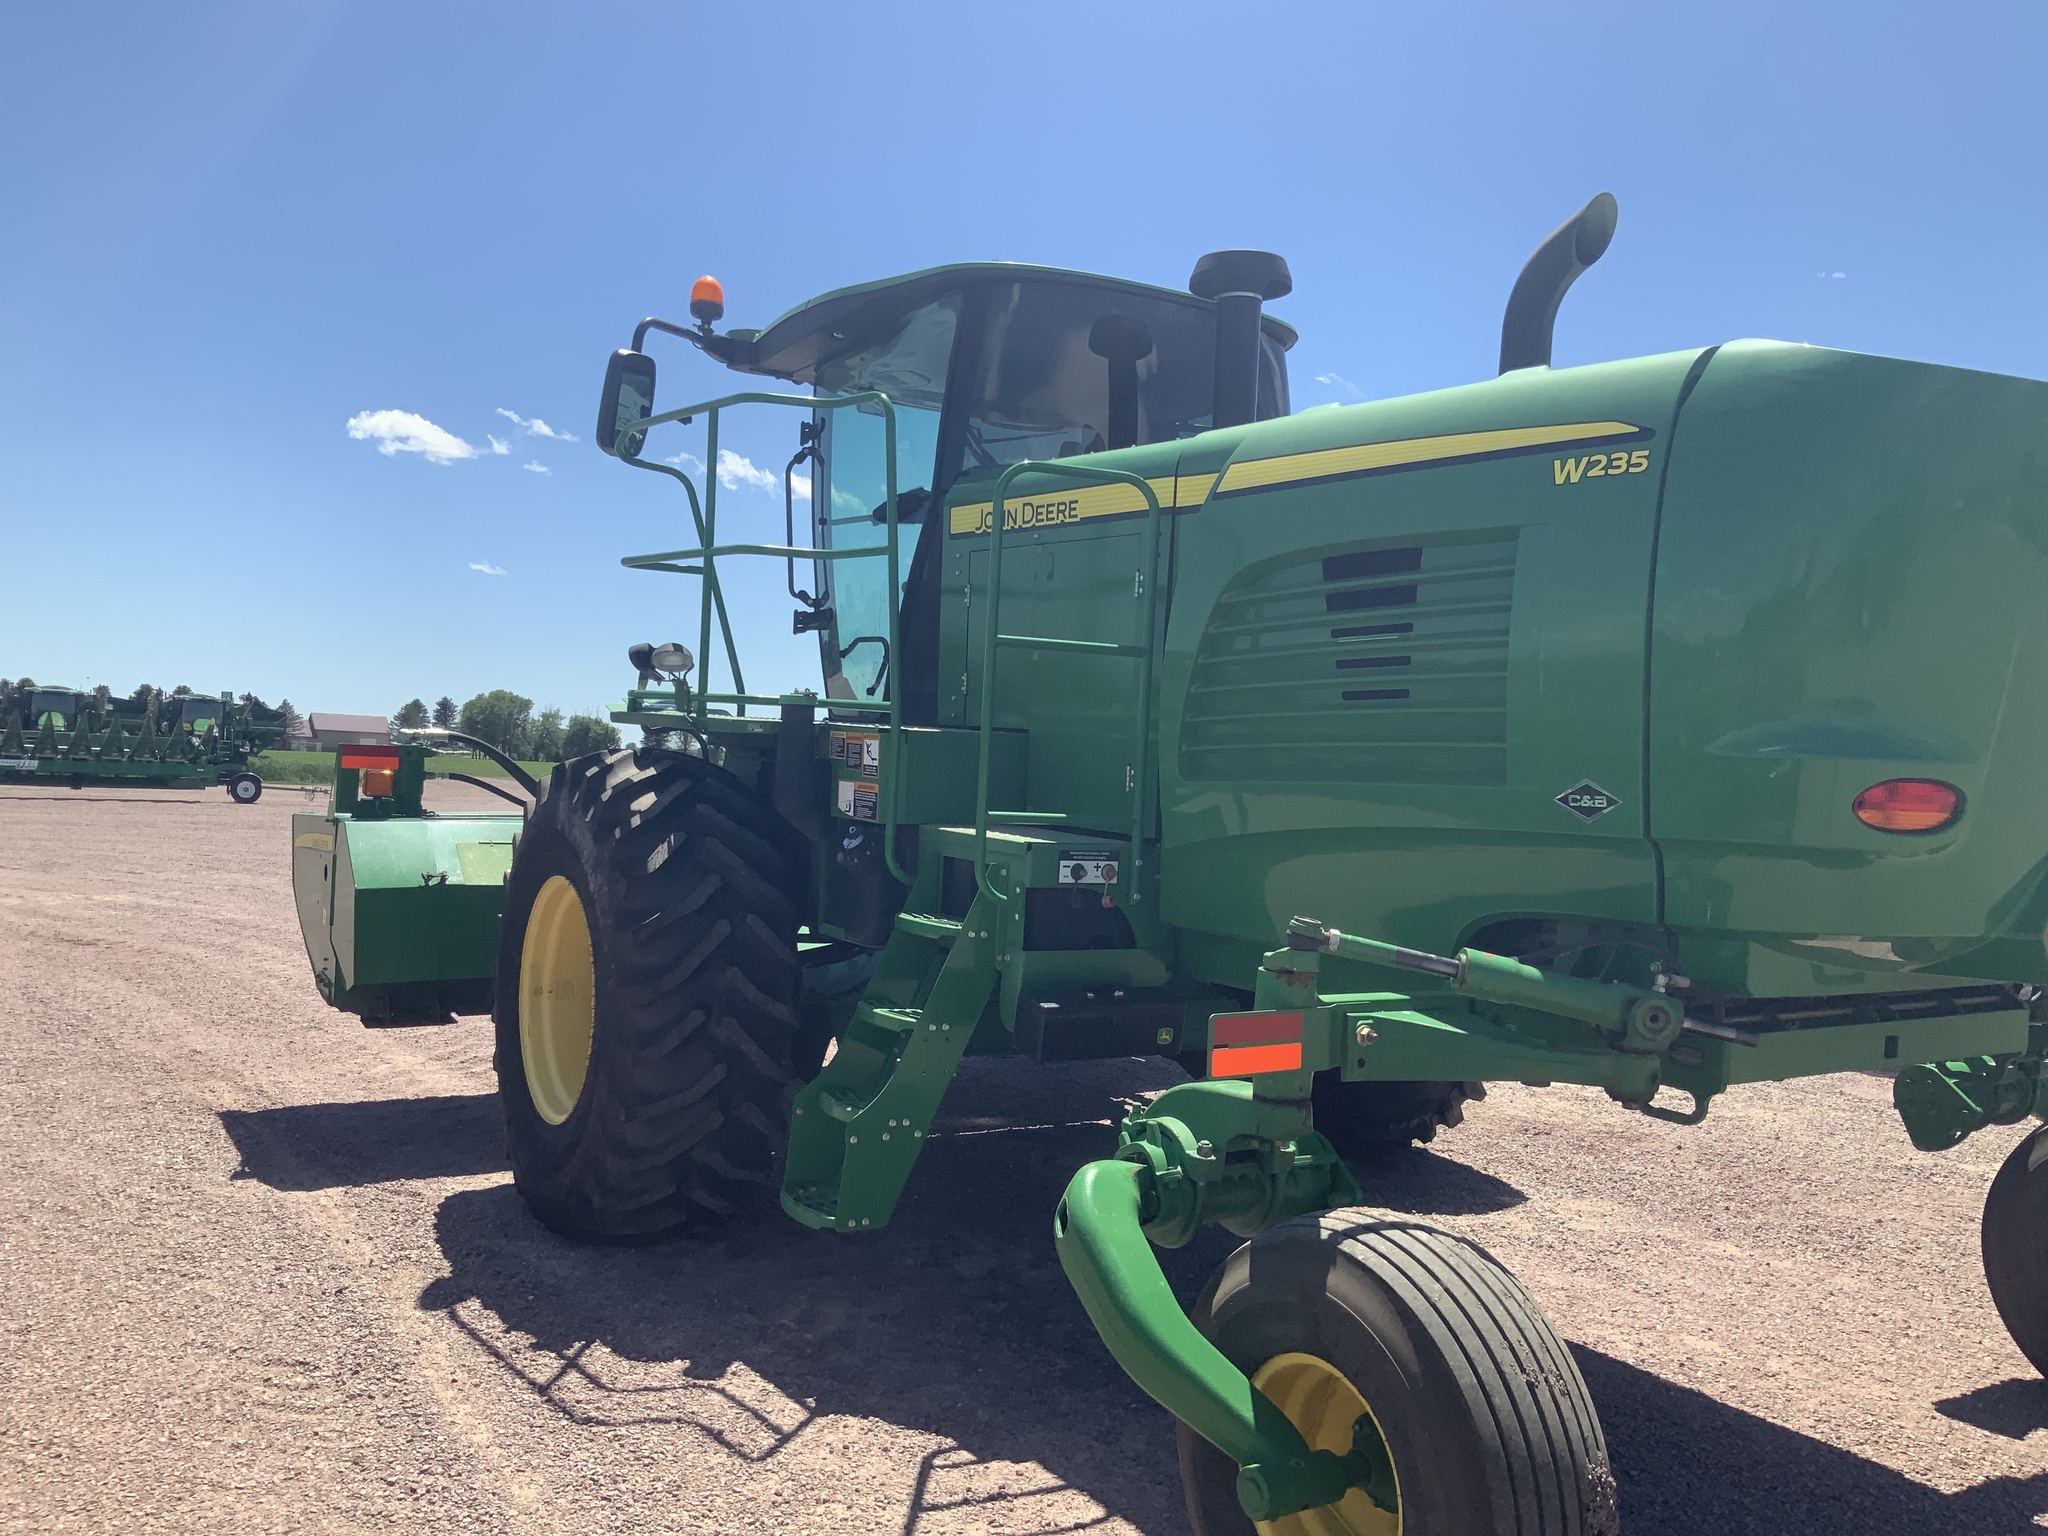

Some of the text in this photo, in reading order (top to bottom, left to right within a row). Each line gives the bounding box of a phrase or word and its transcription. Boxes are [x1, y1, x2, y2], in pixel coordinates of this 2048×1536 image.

[1553, 449, 1650, 485] W235
[975, 499, 1079, 531] JON DEERE
